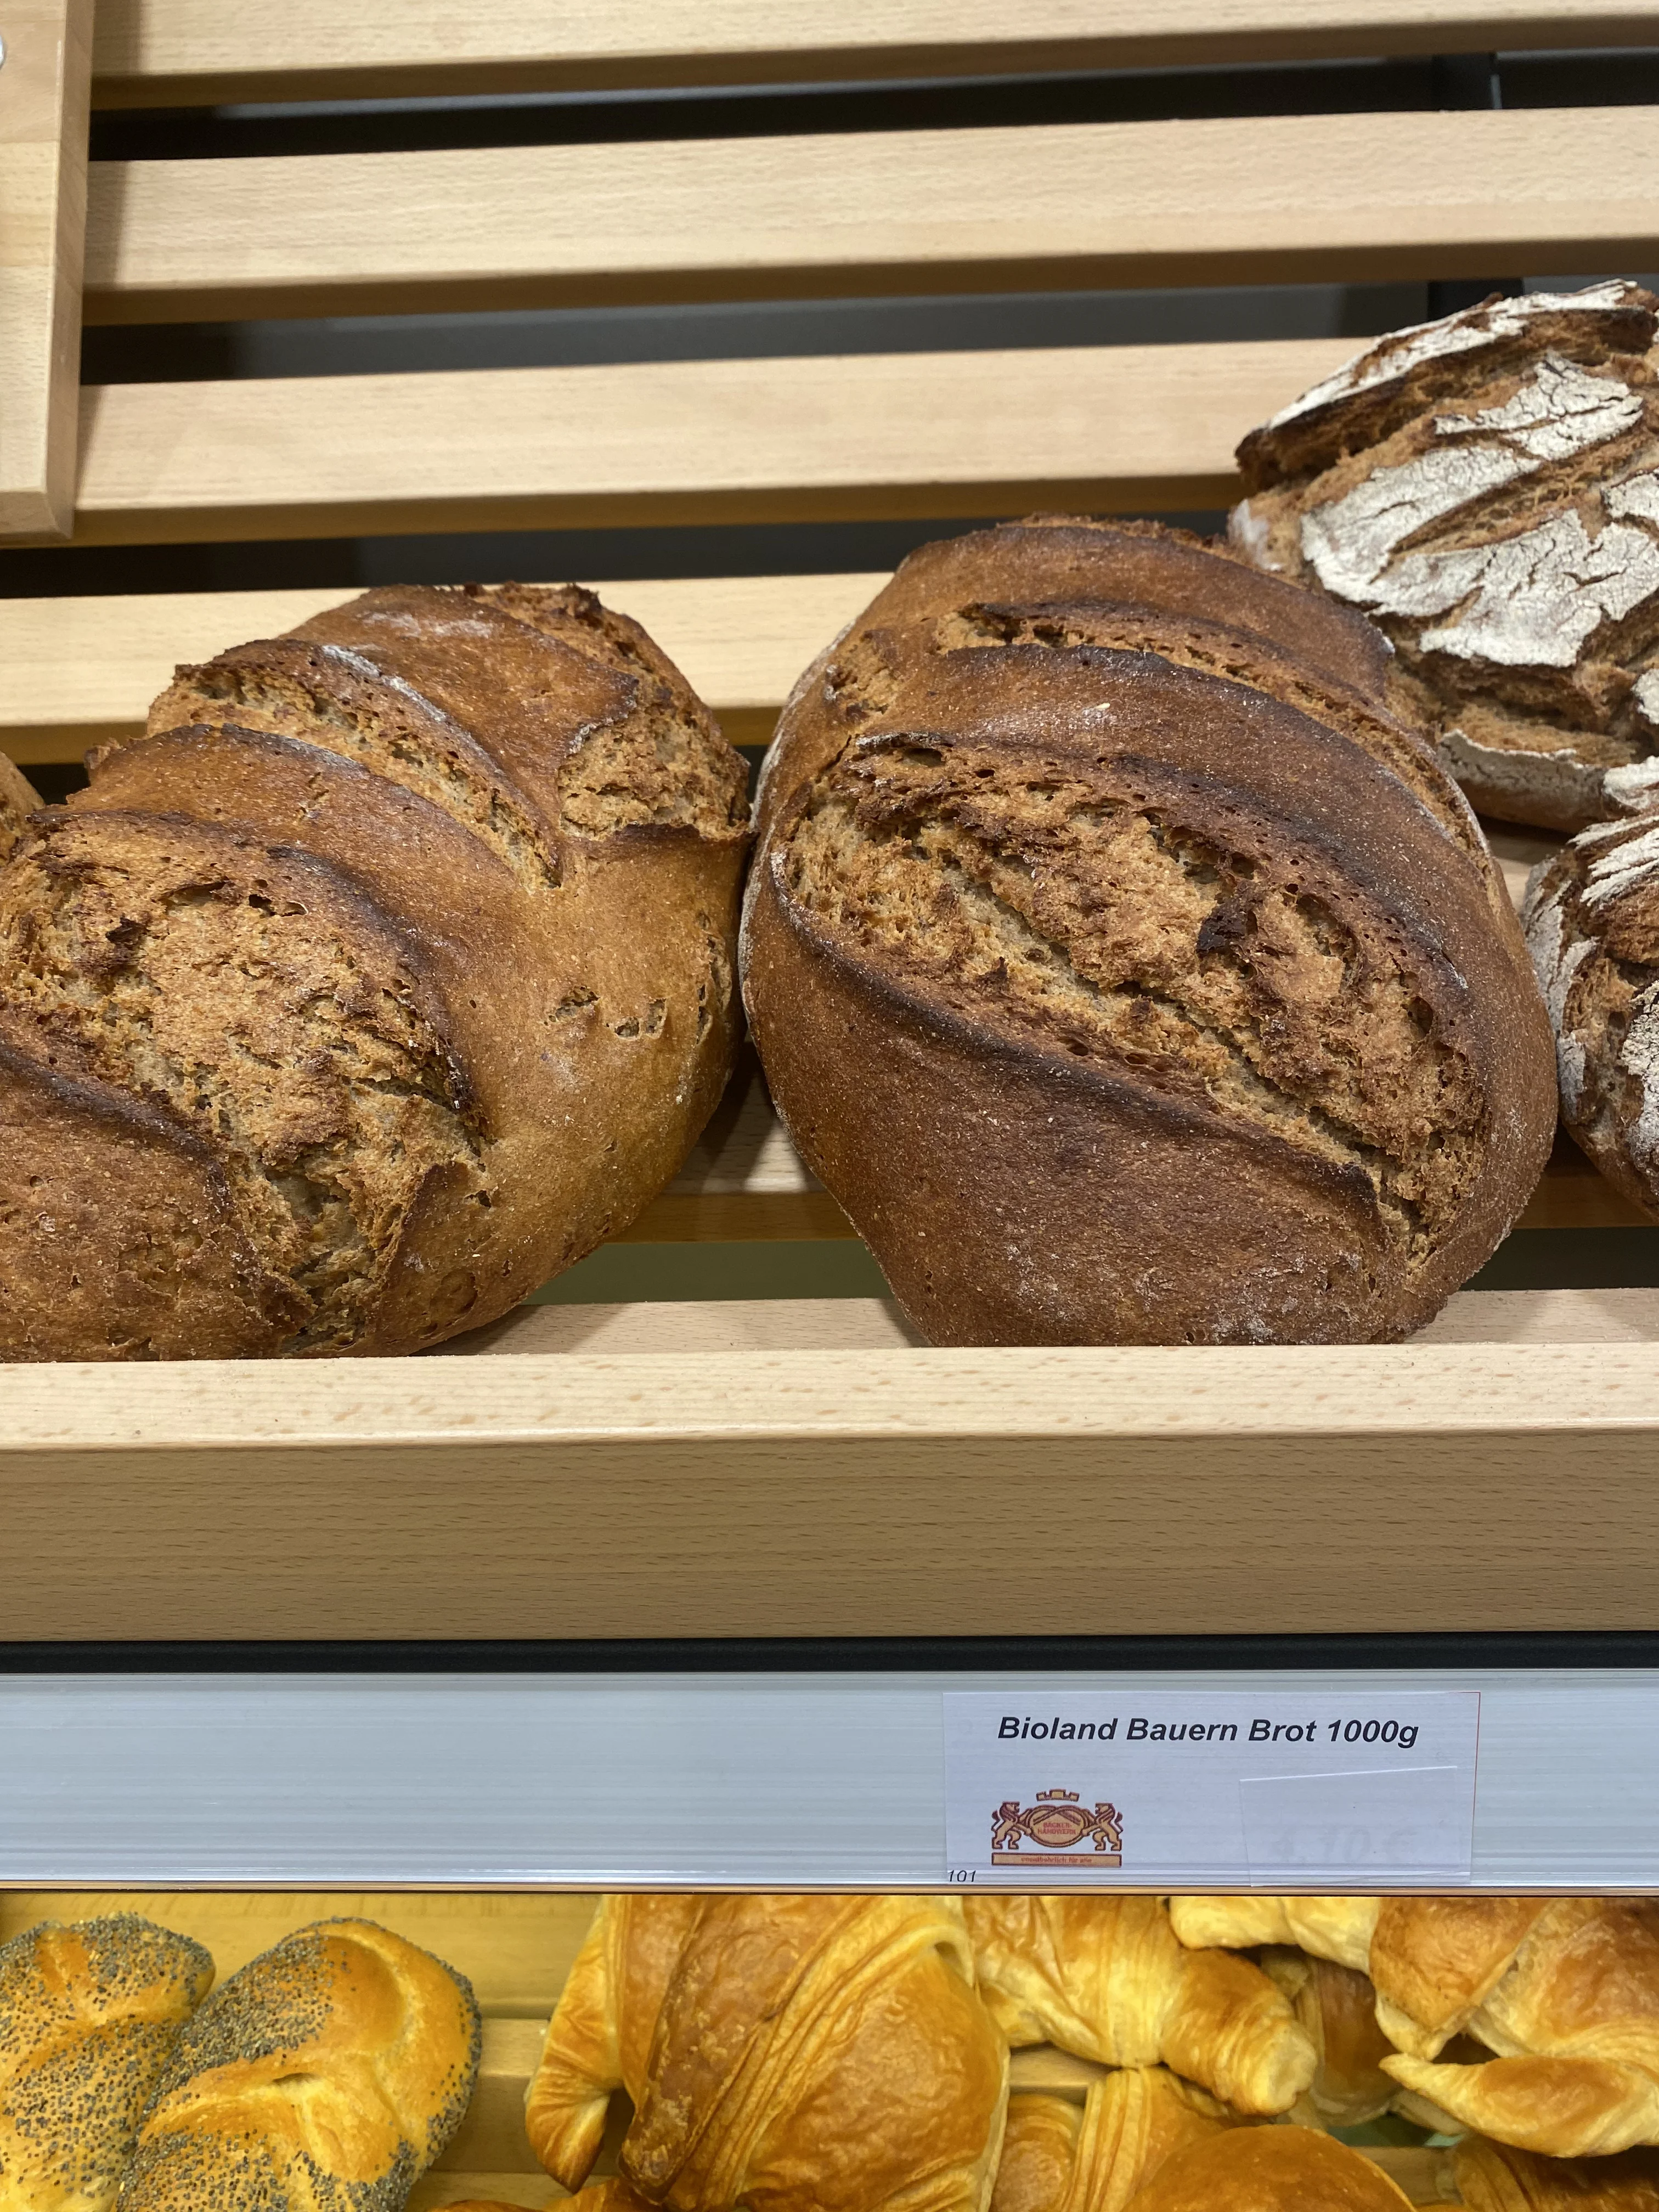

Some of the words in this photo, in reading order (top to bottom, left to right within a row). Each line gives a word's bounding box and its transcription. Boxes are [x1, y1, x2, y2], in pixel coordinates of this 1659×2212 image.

[997, 1717, 1119, 1740] Bioland
[1126, 1718, 1238, 1741] Bauern
[1248, 1718, 1317, 1742] Brot
[1328, 1719, 1419, 1749] 1000g
[947, 1869, 977, 1882] 101
